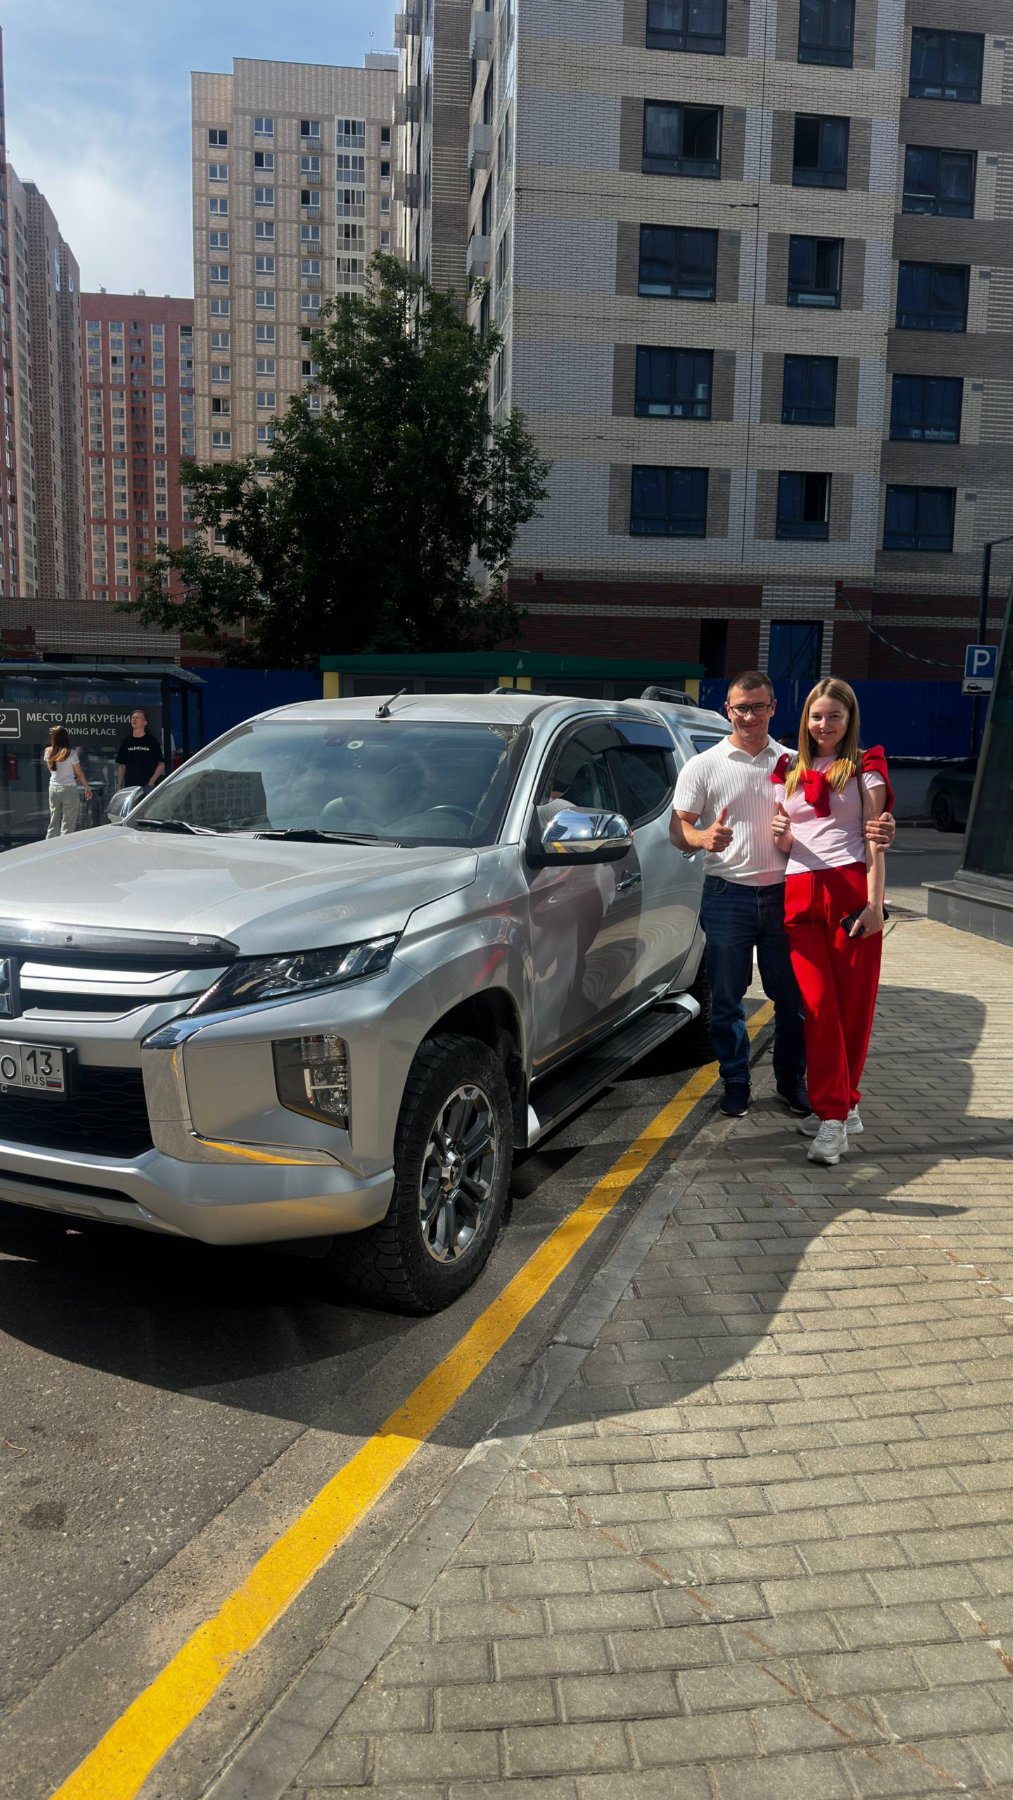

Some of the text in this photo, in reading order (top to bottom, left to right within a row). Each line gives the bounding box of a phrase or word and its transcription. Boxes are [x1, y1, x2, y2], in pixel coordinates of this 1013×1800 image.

[972, 649, 991, 675] P
[26, 712, 131, 724] МЕСТО ДЛЯ КУРЕНИ
[49, 727, 117, 736] SKING PLACE
[26, 1049, 53, 1075] 13
[24, 1074, 46, 1086] RUS
